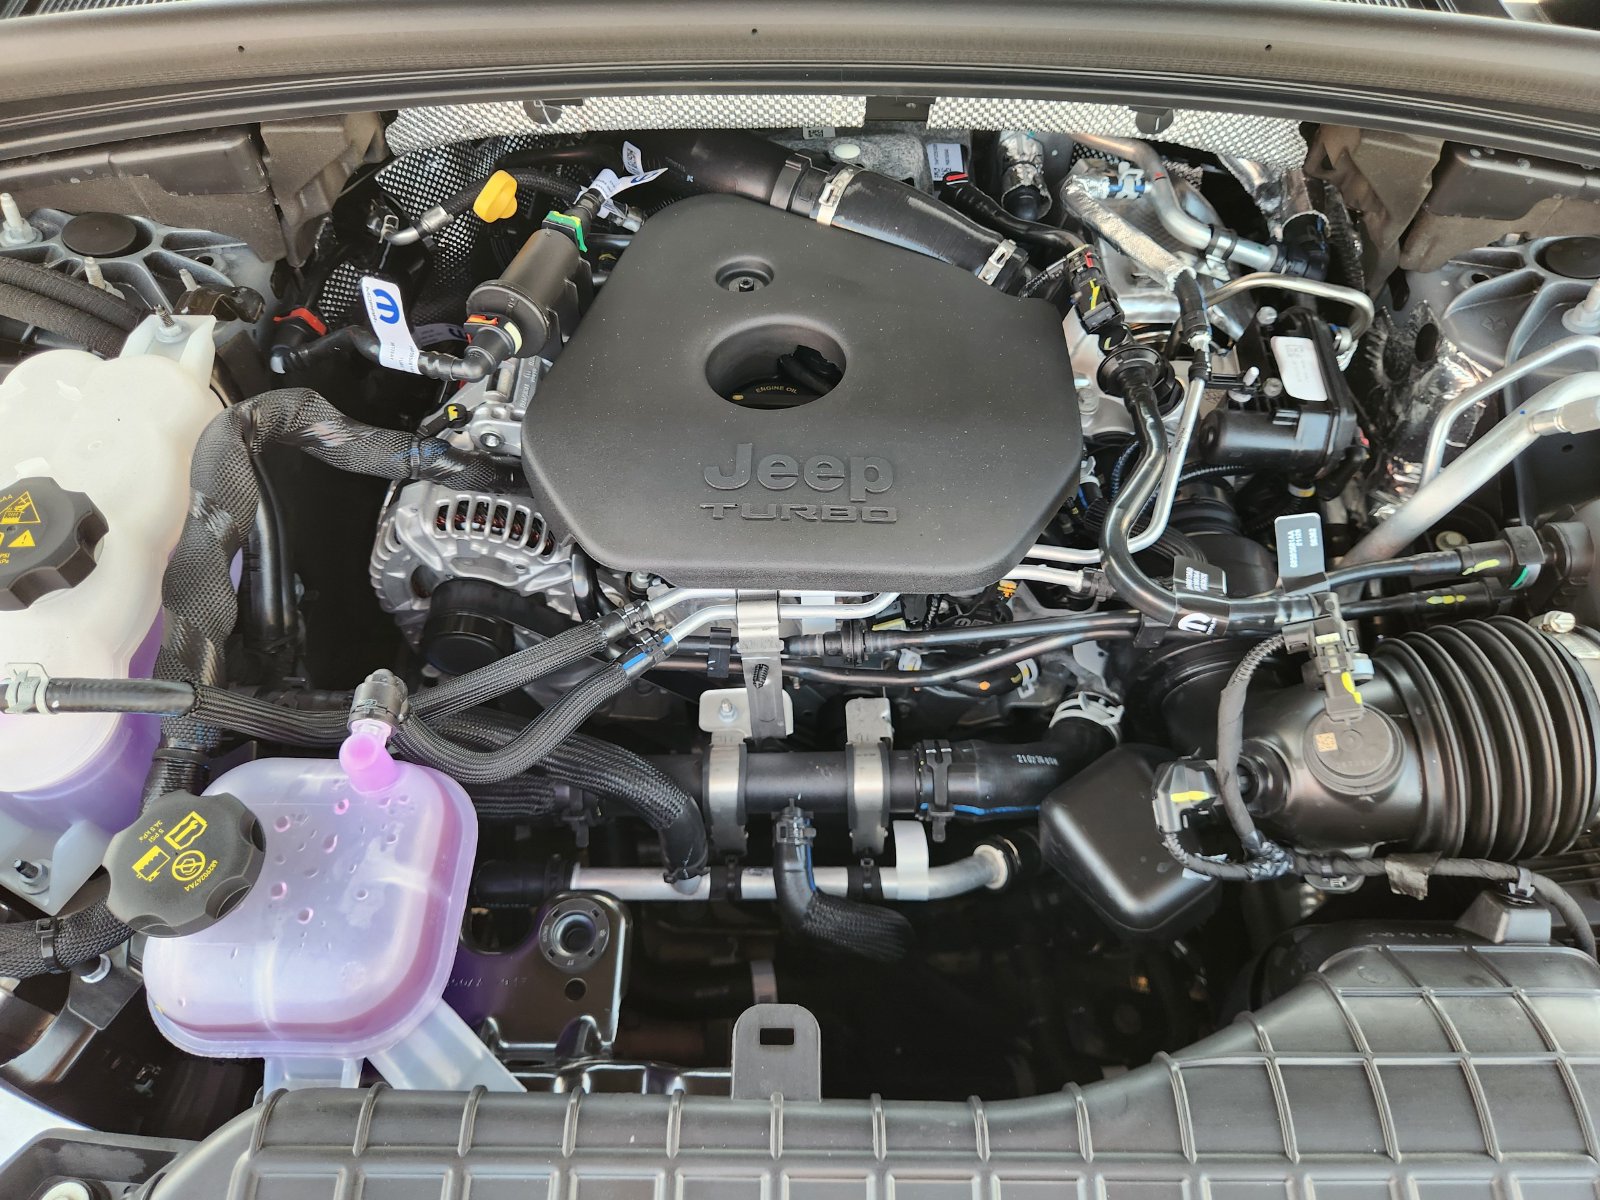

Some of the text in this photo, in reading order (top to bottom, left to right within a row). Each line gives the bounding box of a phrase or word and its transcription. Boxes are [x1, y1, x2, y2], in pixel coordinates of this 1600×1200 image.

[755, 385, 798, 395] ENGINE OIL
[703, 442, 894, 502] Jeep
[699, 502, 898, 523] TURBO
[148, 831, 159, 843] PSI
